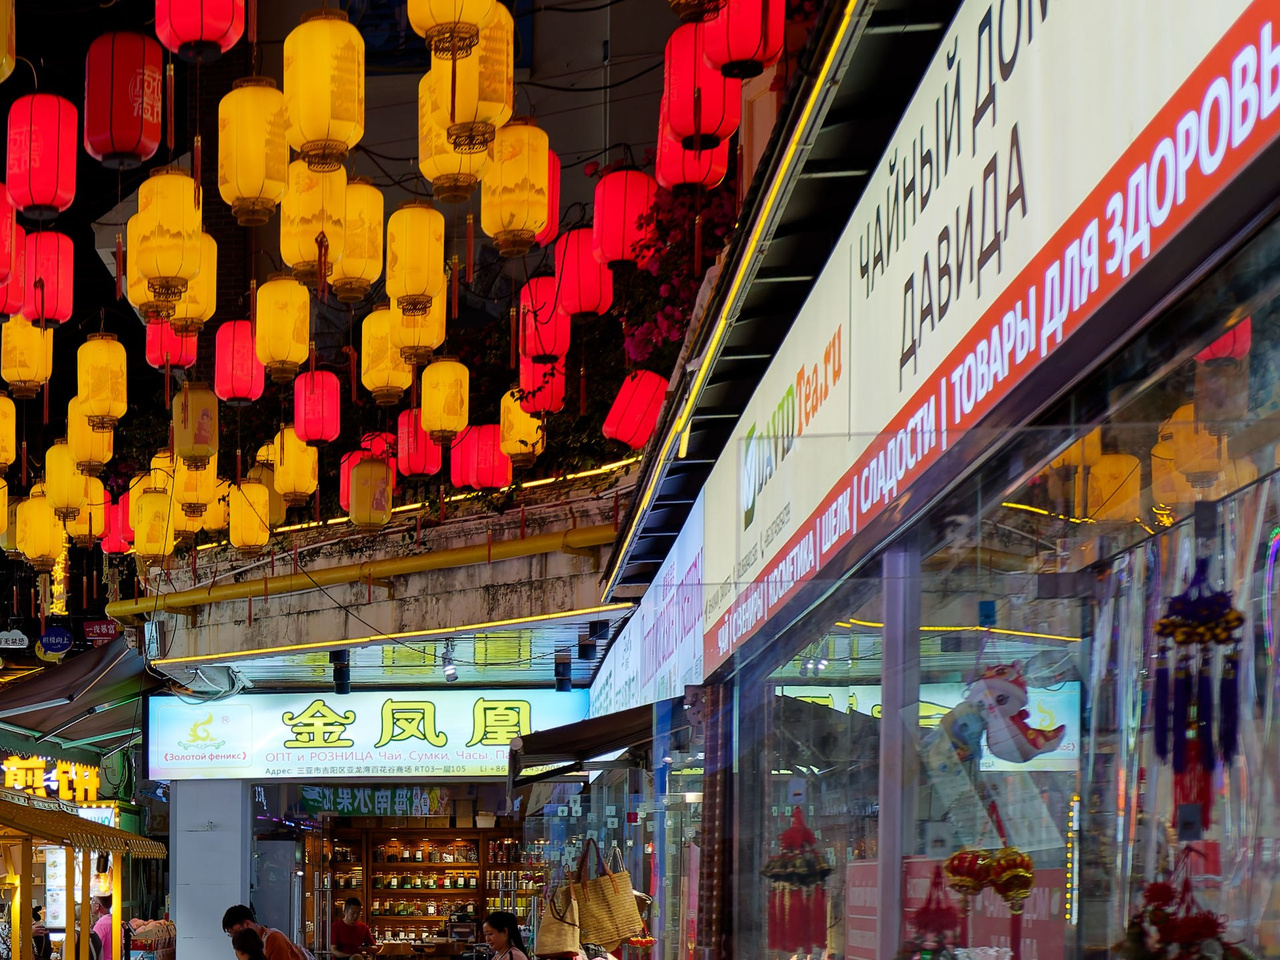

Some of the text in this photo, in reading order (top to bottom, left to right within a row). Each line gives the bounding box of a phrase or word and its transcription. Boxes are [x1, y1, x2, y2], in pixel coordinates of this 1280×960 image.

[858, 35, 962, 299] ЧАЙНЫЙ
[898, 121, 1029, 393] ДАВИДА
[768, 530, 814, 608] КОСМЕТИКА
[821, 490, 850, 555] ШЕЛК
[860, 402, 936, 506] СЛАДОСТИ
[951, 301, 1036, 418] ТОВАРЫ
[1040, 218, 1099, 358] ДЛЯ
[265, 752, 292, 762] ОПТ
[310, 751, 373, 762] РОЗНИЦА
[409, 750, 450, 762] Сумки,
[281, 697, 534, 748] 金凤凰
